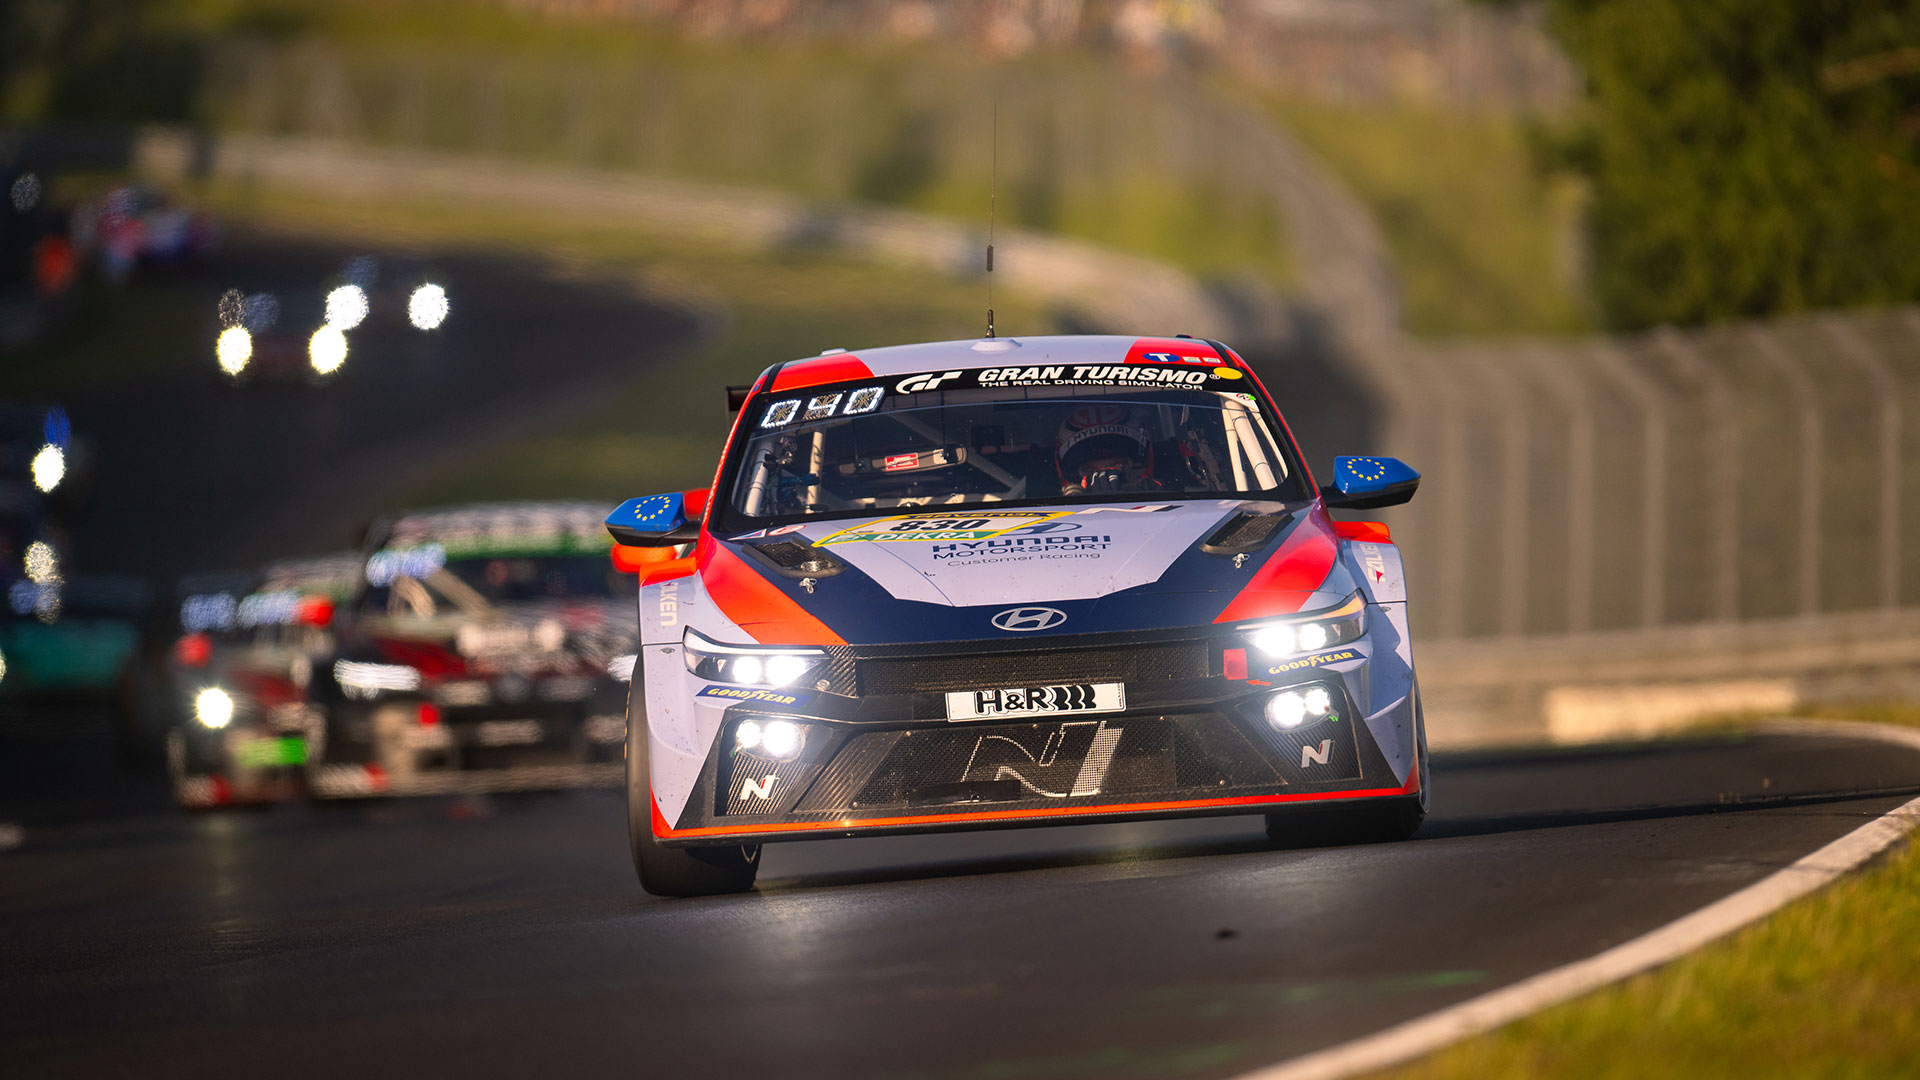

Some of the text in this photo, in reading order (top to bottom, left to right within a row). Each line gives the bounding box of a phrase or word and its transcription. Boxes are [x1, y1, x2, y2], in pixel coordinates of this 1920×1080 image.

[977, 366, 1207, 384] GRAN TURISMO
[1118, 380, 1203, 390] SIMULATOR
[761, 387, 884, 428] 040
[890, 519, 991, 532] 830
[873, 531, 975, 541] DEKRA
[932, 535, 1112, 552] HYUNDAI
[933, 543, 1112, 560] MOTORSPORT
[947, 552, 1101, 567] Customer Racing
[1268, 651, 1354, 675] GOODYEAR
[707, 688, 797, 705] GOODYEAR
